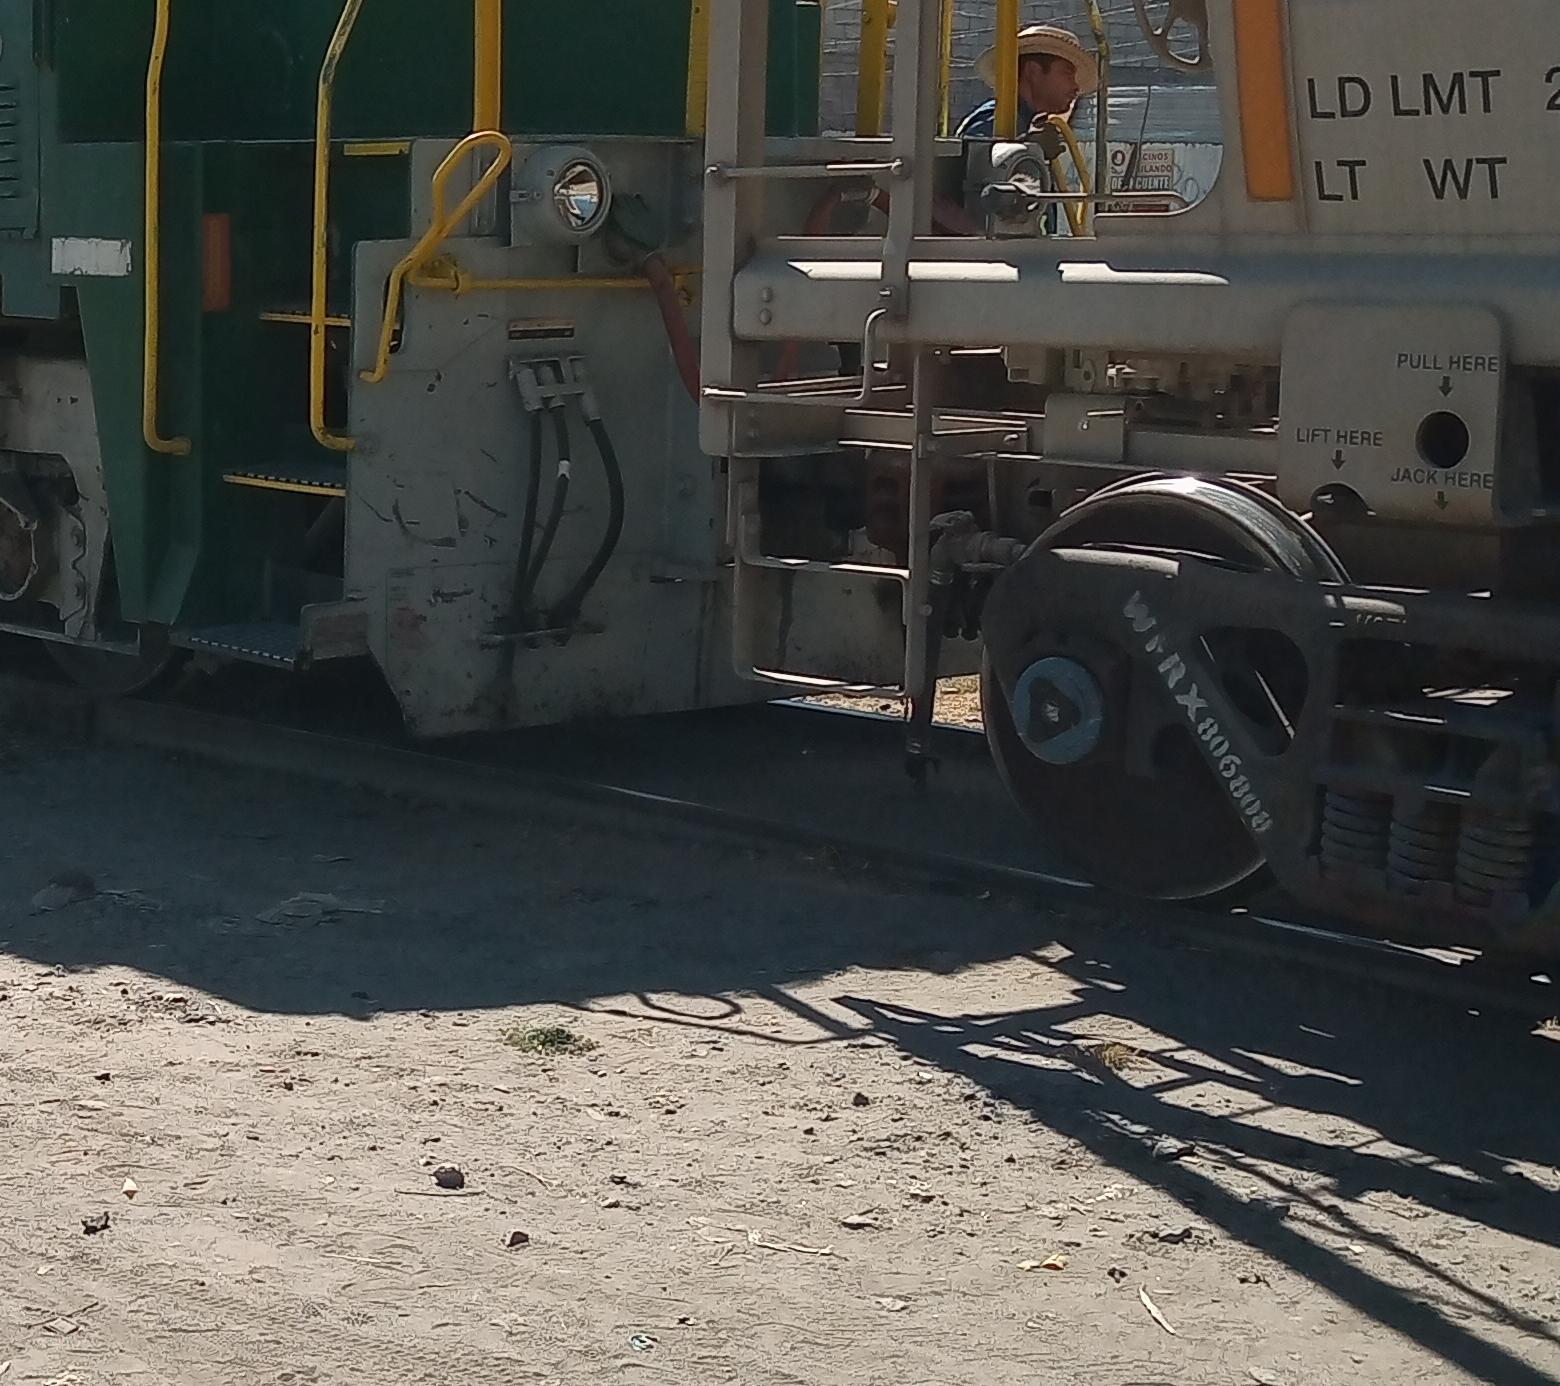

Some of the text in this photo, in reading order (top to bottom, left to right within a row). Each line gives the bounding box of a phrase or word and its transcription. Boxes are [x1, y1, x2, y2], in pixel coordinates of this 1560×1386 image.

[1307, 76, 1371, 119] LD
[1390, 69, 1501, 116] LMT
[1315, 157, 1507, 201] LT WT
[1397, 353, 1498, 373] PULL HERE
[1296, 428, 1383, 447] LIFT HERE
[1391, 467, 1494, 490] JACK HERE
